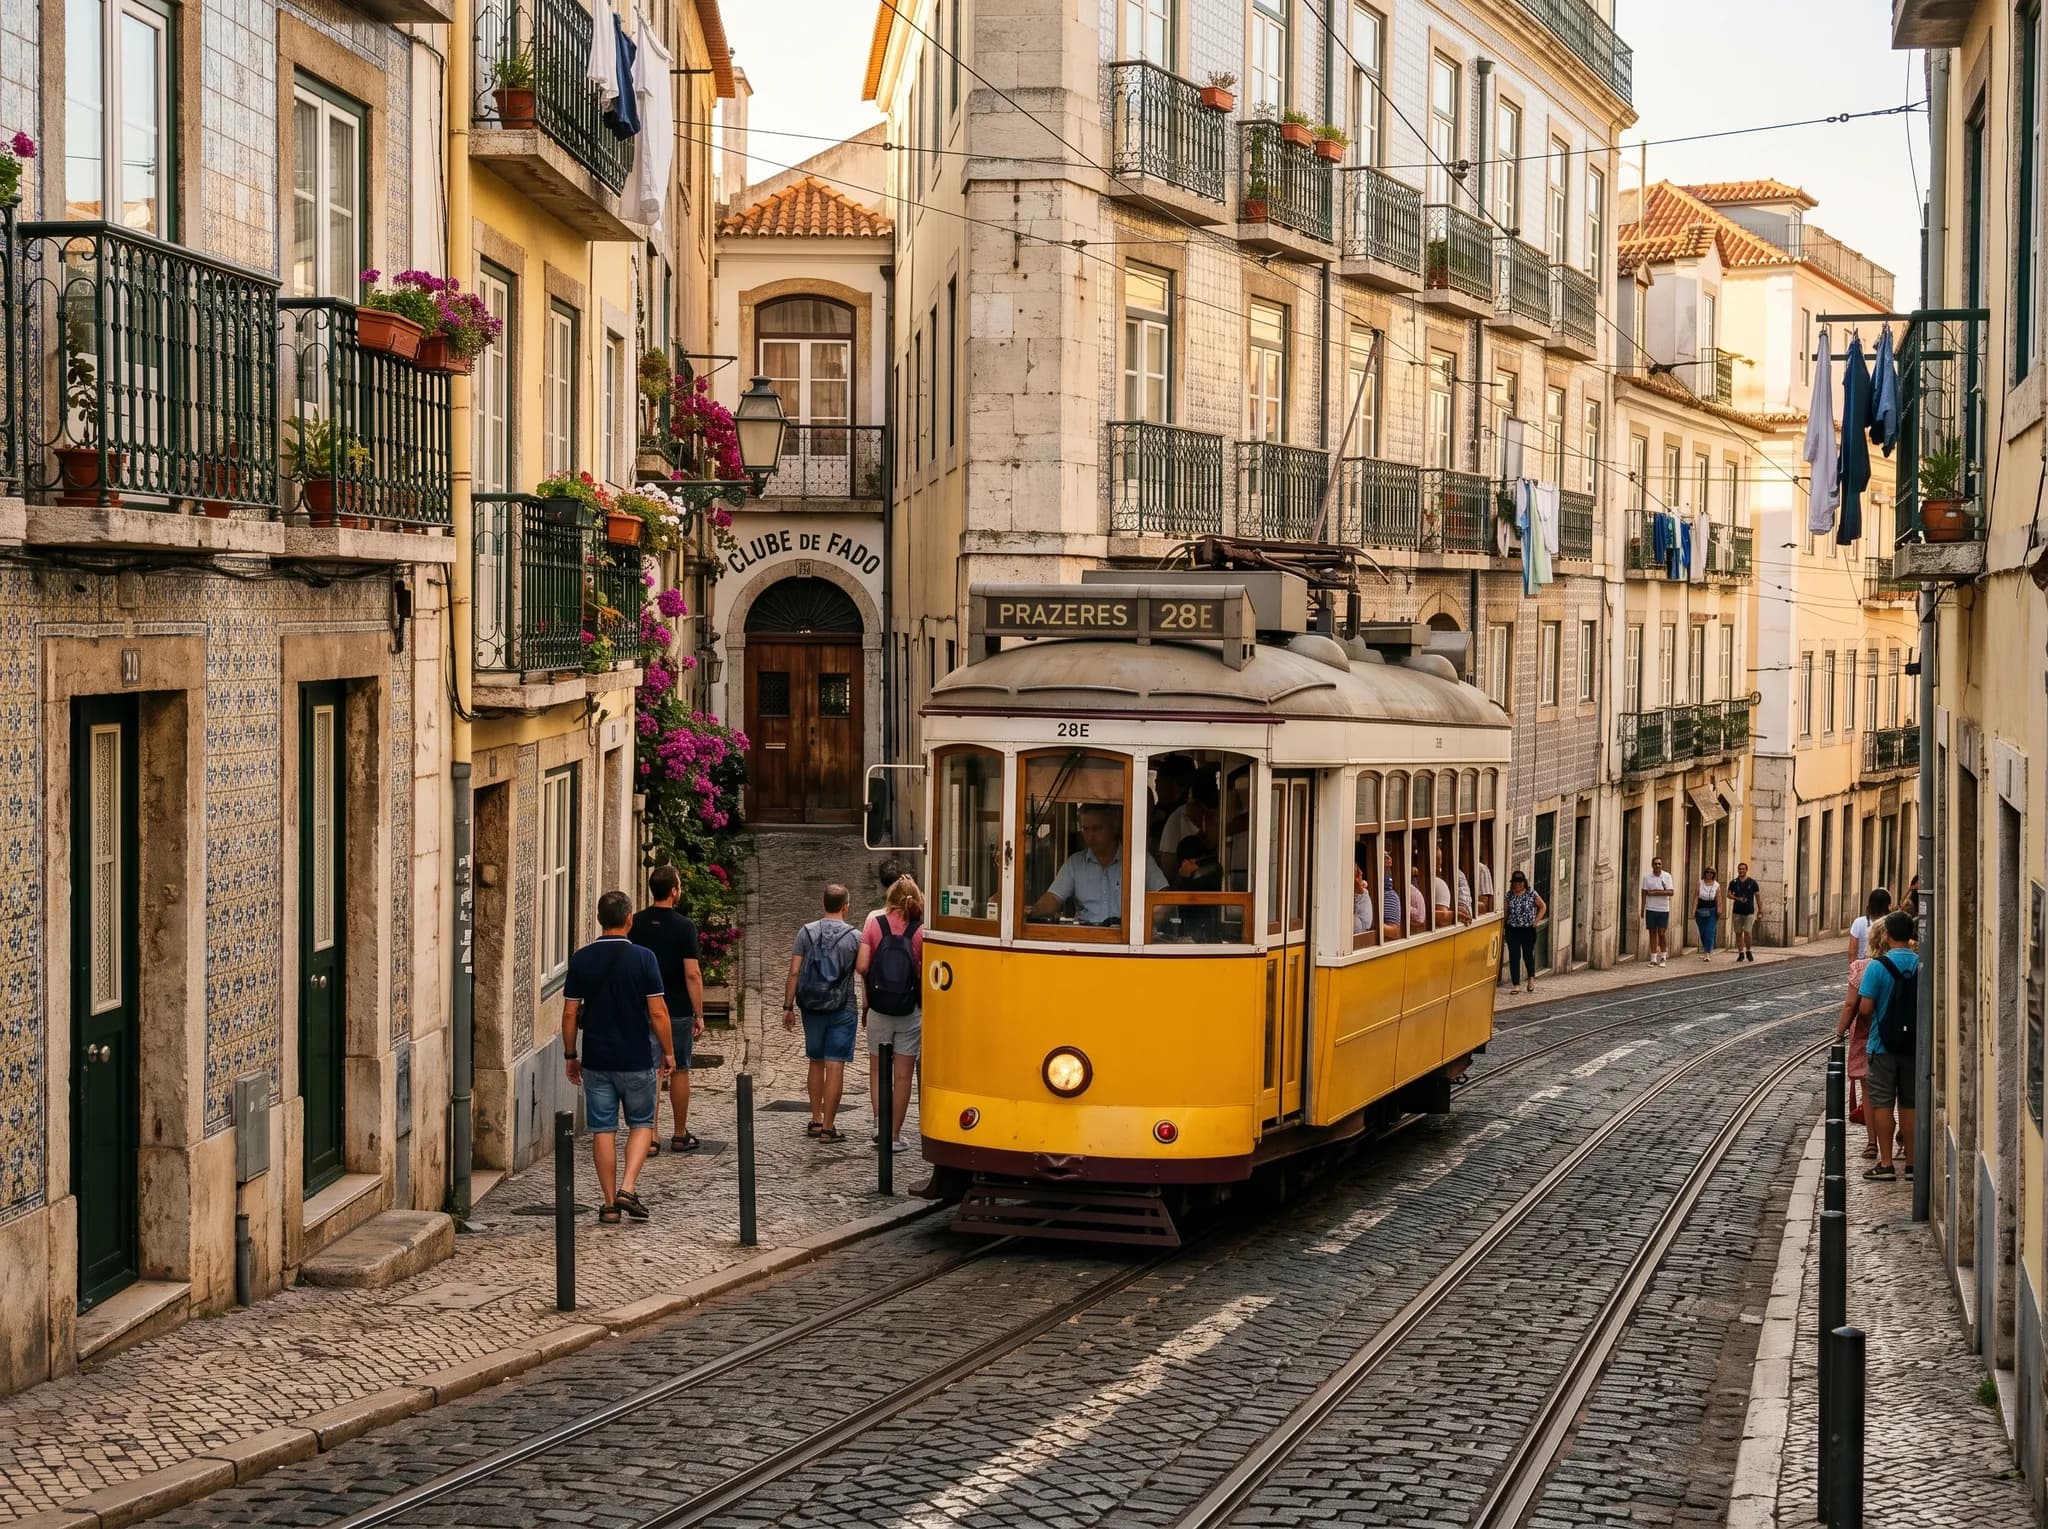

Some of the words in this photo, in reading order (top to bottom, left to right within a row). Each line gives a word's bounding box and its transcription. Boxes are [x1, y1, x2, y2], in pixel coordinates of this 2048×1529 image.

[727, 529, 793, 574] CLUBE
[799, 533, 821, 551] DE
[826, 532, 881, 575] FADO
[999, 603, 1128, 626] PRAZERES
[1159, 603, 1213, 629] 28E
[1056, 722, 1090, 738] 28E
